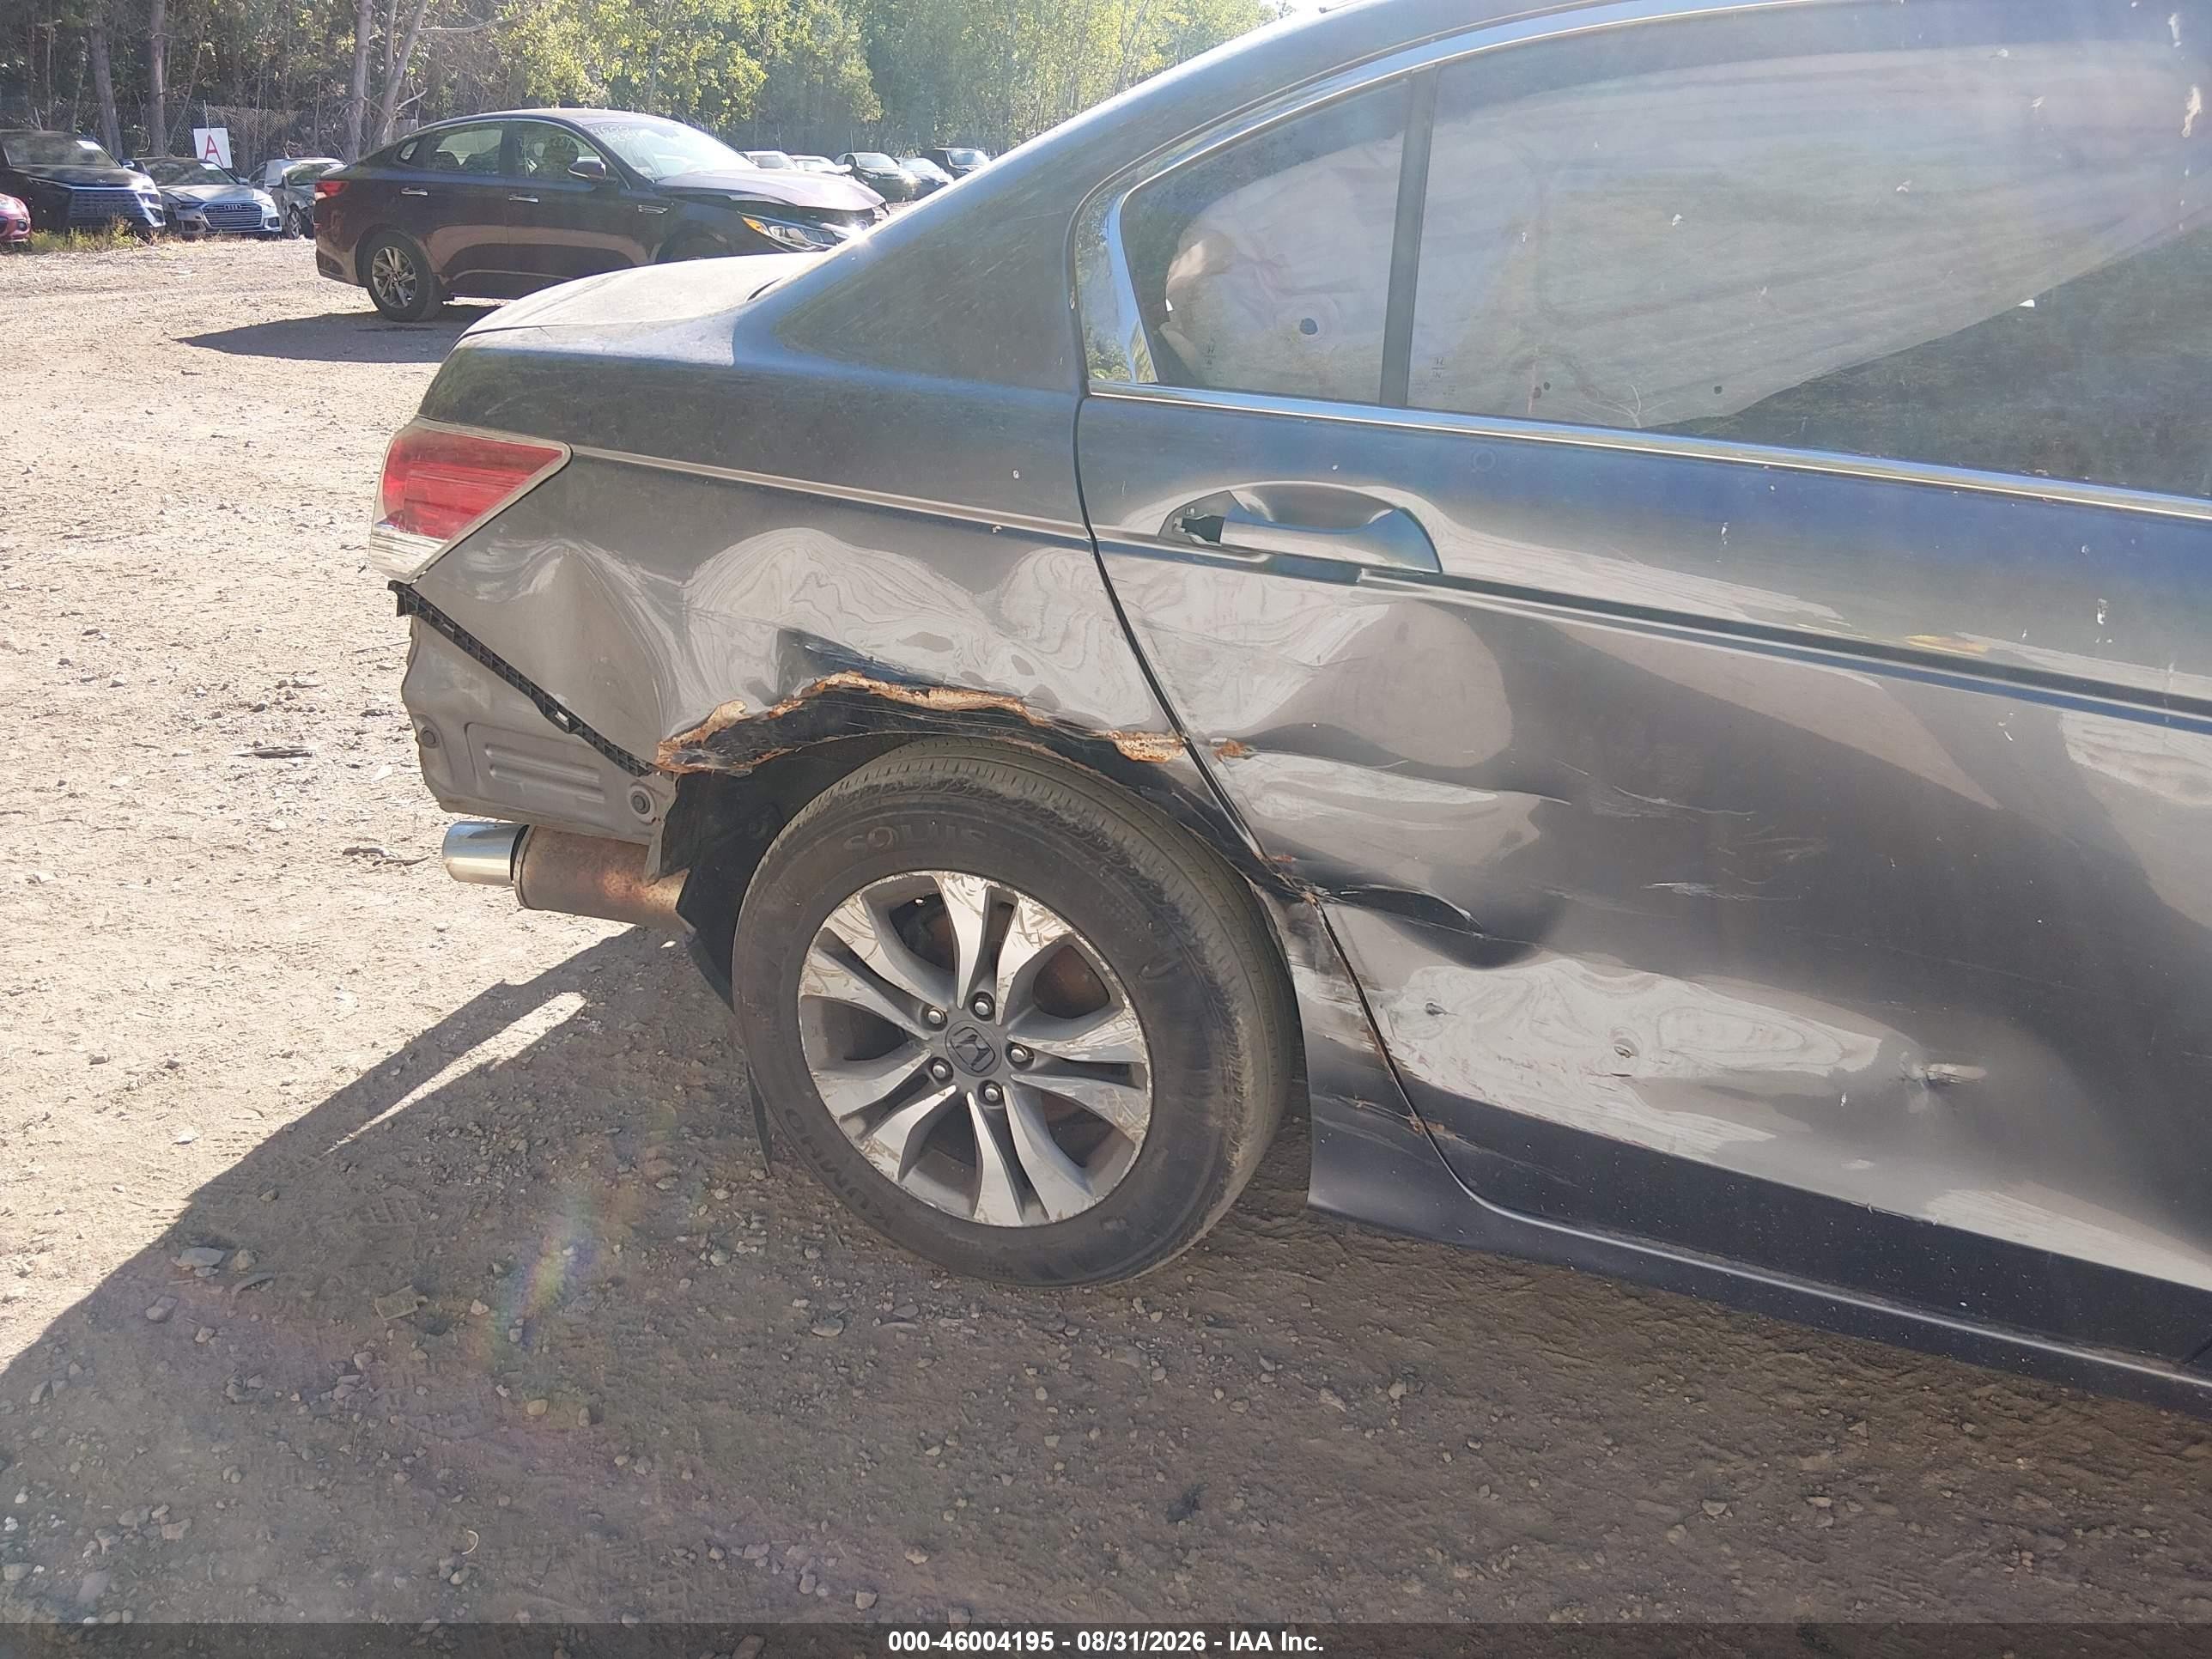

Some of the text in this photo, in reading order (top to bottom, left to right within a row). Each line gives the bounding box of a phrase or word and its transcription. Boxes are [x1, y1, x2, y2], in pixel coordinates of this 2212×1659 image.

[204, 134, 224, 167] A
[842, 823, 991, 854] SOLUS
[785, 1108, 893, 1231] KUMHO
